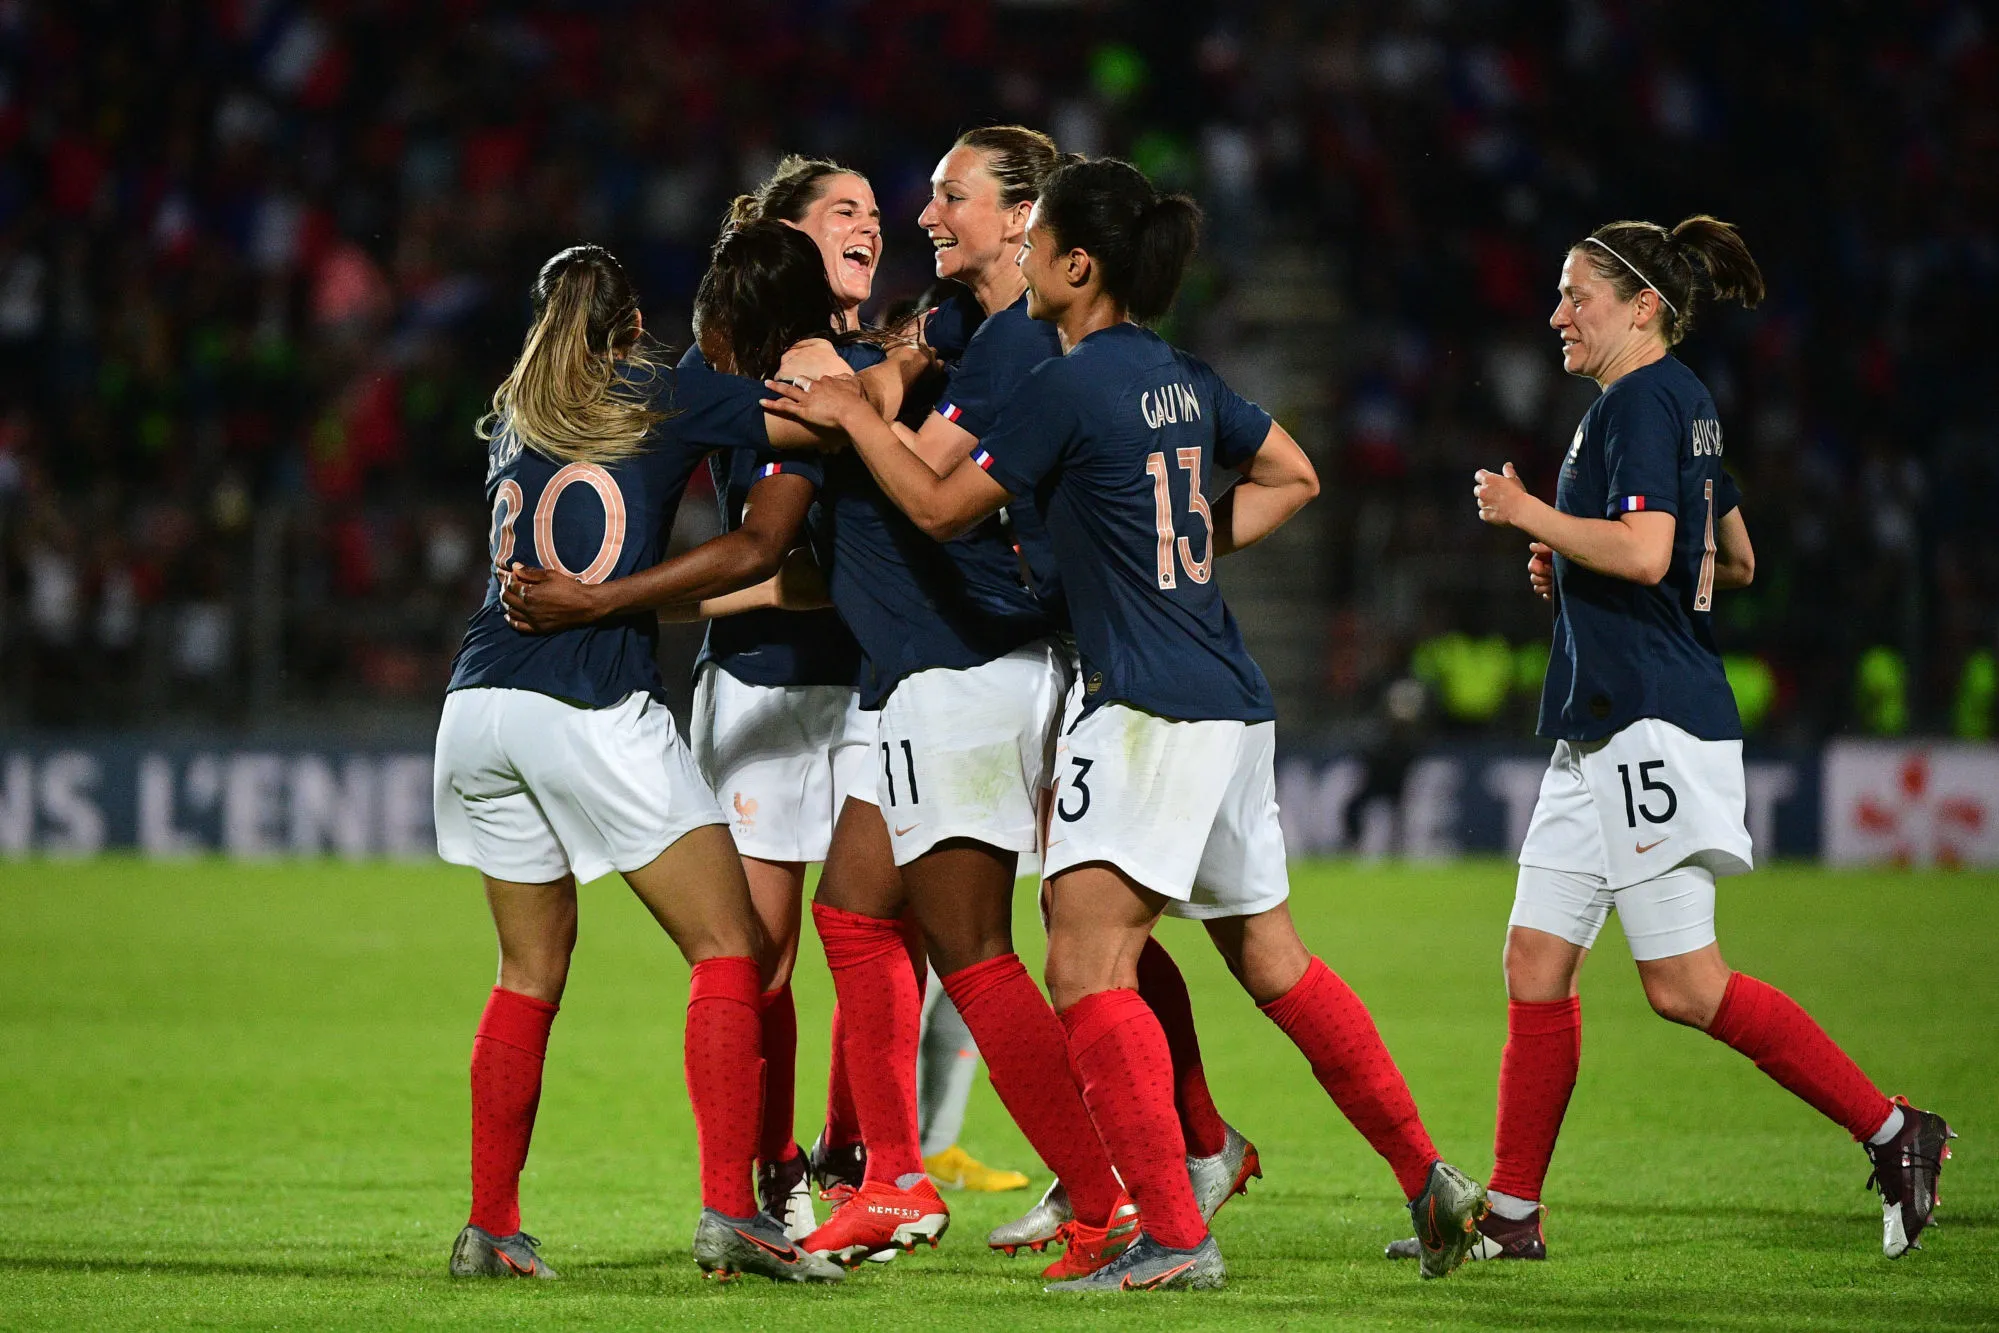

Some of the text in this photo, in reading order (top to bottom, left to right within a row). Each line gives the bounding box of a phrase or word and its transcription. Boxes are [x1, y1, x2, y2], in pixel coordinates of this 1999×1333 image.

[1141, 382, 1201, 429] GAUVIN
[1146, 446, 1213, 589] 13
[881, 738, 919, 807] 11
[1057, 756, 1094, 823] 3
[1617, 759, 1678, 828] 15
[868, 1204, 920, 1217] NEMESIS
